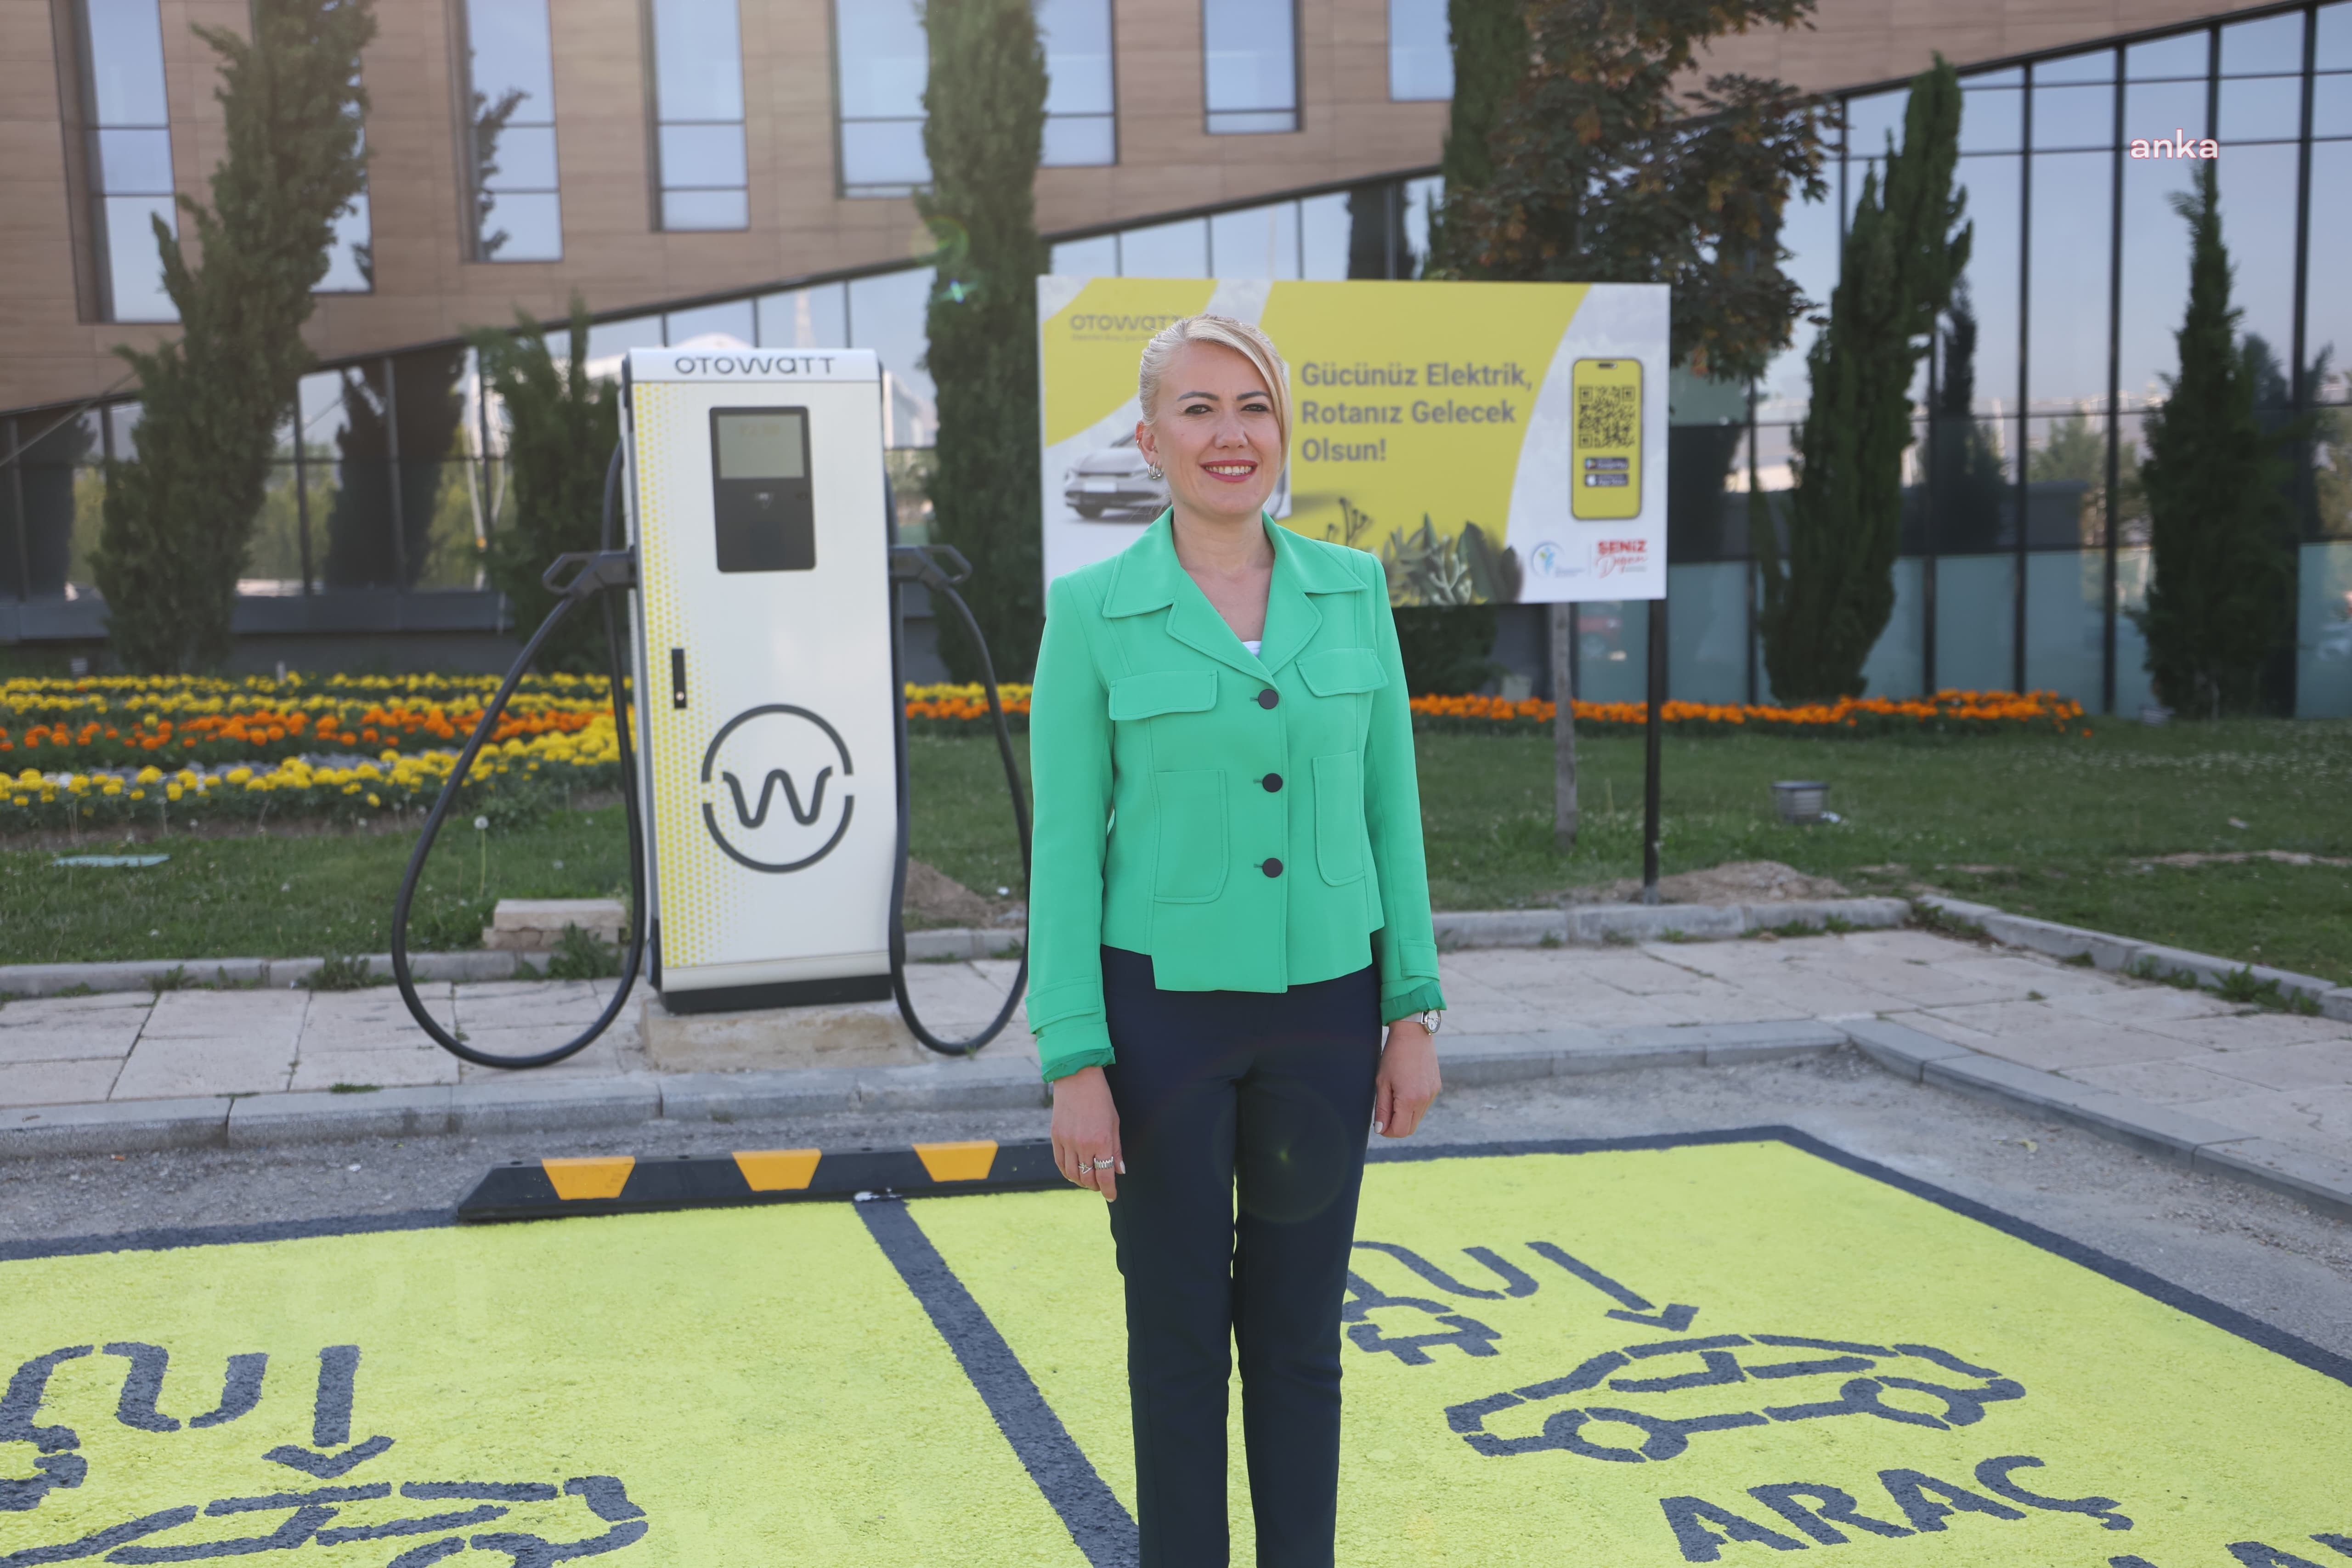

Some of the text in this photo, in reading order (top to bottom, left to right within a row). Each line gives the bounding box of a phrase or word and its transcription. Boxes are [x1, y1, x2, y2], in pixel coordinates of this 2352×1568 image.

[1301, 362, 1532, 391] Gücünüz Elektrik,
[1301, 399, 1517, 424] Rotanız Gelecek
[1301, 437, 1386, 462] Olsun!
[1660, 1455, 2134, 1562] ARAÇ
